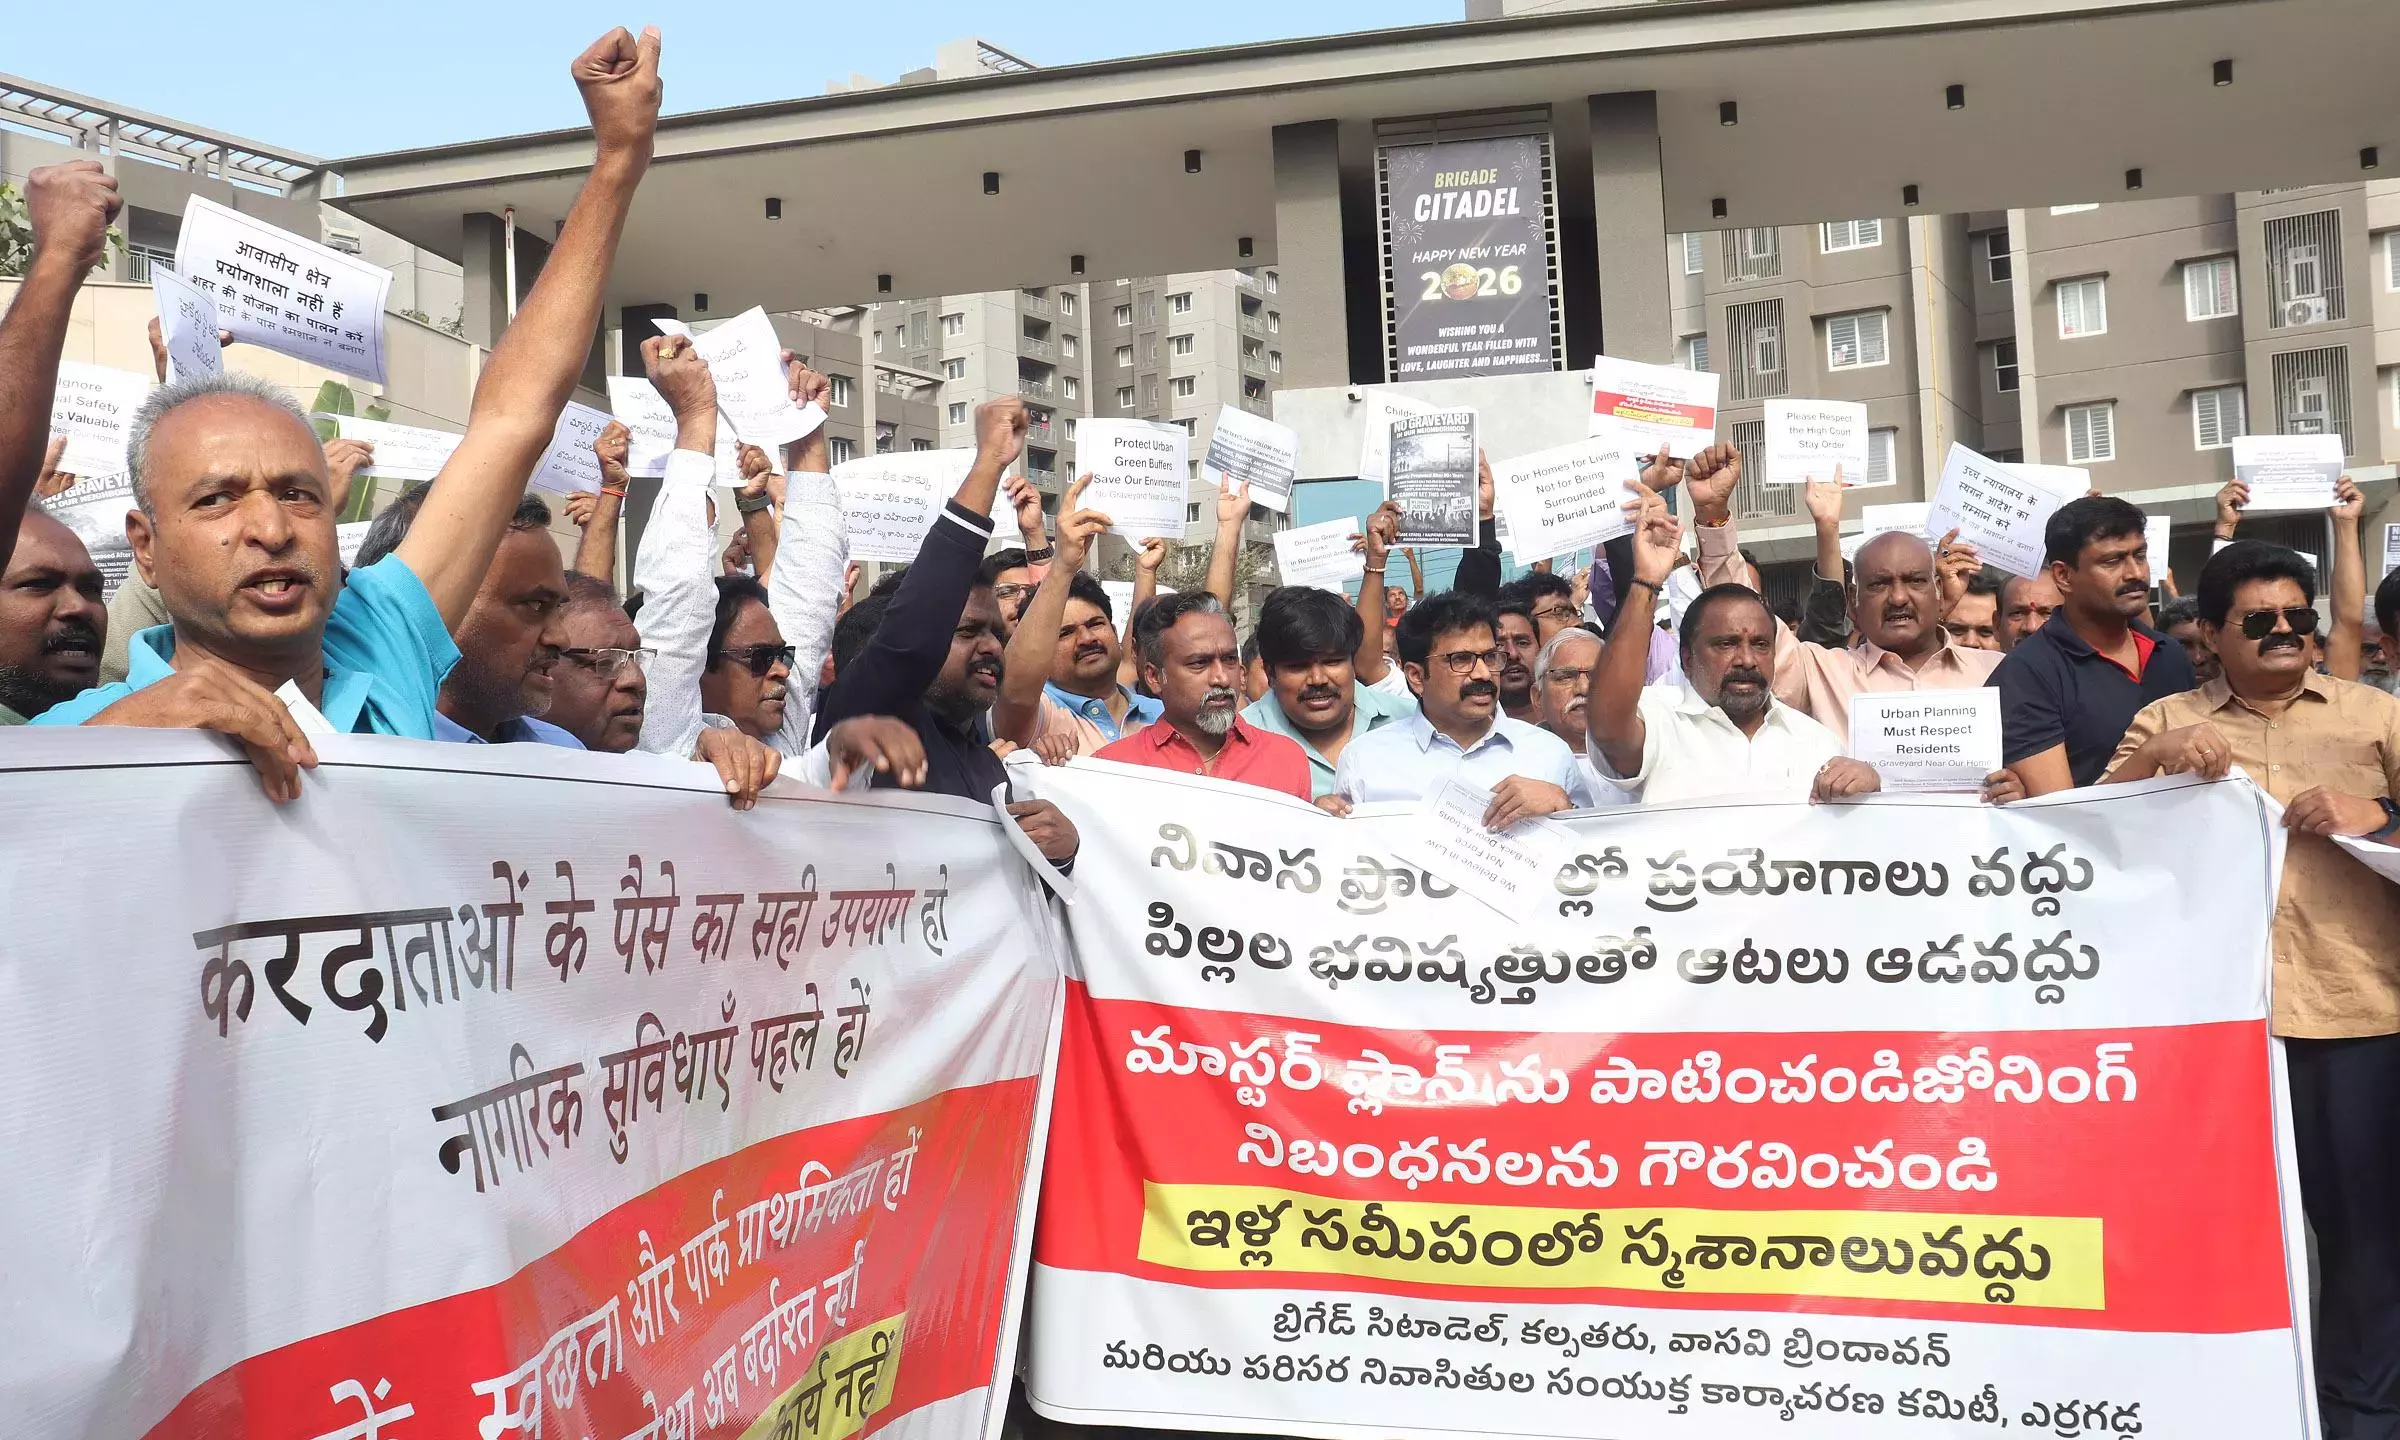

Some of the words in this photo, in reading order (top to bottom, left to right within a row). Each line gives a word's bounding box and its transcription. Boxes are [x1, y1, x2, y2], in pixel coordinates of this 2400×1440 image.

[1434, 168, 1498, 189] BRIGADE
[1414, 187, 1520, 223] CITADEL
[1412, 249, 1454, 264] HAPPY
[1458, 246, 1491, 261] NEW
[1493, 243, 1527, 257] YEAR
[235, 240, 299, 276] आवासीय
[306, 267, 332, 289] क्षेत्र
[216, 259, 290, 299] प्रयोगशाला
[297, 290, 324, 312] नहीं
[192, 274, 217, 293] शहर
[222, 285, 237, 300] की
[243, 295, 279, 316] योजना
[285, 310, 300, 323] का
[307, 317, 338, 335] पालन
[256, 317, 276, 330] पास
[1438, 325, 1476, 337] WISHING
[1479, 324, 1496, 335] YOU
[1497, 323, 1505, 334] A
[1407, 342, 1460, 356] WONDERFUL
[1461, 341, 1483, 353] YEAR
[1485, 340, 1512, 351] FILLED
[1514, 337, 1538, 349] WITH
[1400, 360, 1424, 373] LOVE,
[1426, 358, 1469, 370] LAUGHTER
[1471, 356, 1490, 367] AND
[58, 377, 103, 393] Ignore
[76, 396, 119, 414] Safety
[68, 411, 120, 430] Valuable
[1408, 413, 1470, 429] GRAVEYARD
[1786, 412, 1817, 421] Please
[1819, 412, 1852, 422] Respect
[1789, 426, 1804, 435] the
[1807, 426, 1827, 436] High
[1829, 427, 1851, 437] Court
[1114, 437, 1151, 450] Protect
[1153, 440, 1174, 452] Urban
[1798, 440, 1819, 450] Stay
[1821, 440, 1845, 449] Order
[1114, 456, 1147, 468] Green
[1149, 458, 1173, 471] Buffers
[1510, 473, 1530, 484] Our
[1533, 464, 1570, 478] Homes
[1572, 458, 1586, 468] for
[1589, 451, 1620, 463] Living
[64, 471, 132, 499] GRAVEYA
[1094, 474, 1121, 484] Save
[1124, 475, 1142, 485] Our
[1144, 476, 1181, 488] Environment
[1536, 483, 1555, 494] Not
[1558, 479, 1572, 488] for
[1575, 471, 1605, 484] Being
[1962, 465, 1981, 480] उच्च
[1983, 475, 2024, 500] न्यायालय
[2027, 494, 2038, 507] के
[1544, 486, 1606, 509] Surrounded
[1542, 517, 1555, 527] by
[1557, 507, 1588, 523] Burial
[1590, 500, 1616, 514] Land
[1962, 501, 1992, 522] सम्मान
[1986, 496, 2013, 514] आदेश
[2016, 509, 2030, 522] का
[1881, 708, 1920, 719] Urban
[1924, 706, 1977, 717] Planning
[1883, 726, 1916, 737] Must
[1920, 725, 1972, 737] Respect
[1896, 743, 1961, 754] Residents
[1879, 759, 1923, 769] Graveyard
[1925, 759, 1945, 767] Near
[1948, 759, 1964, 767] Our
[1966, 759, 1992, 767] Home
[1439, 810, 1474, 834] Actions
[1426, 839, 1447, 856] Law
[1455, 837, 1484, 857] Force
[1475, 832, 1498, 848] Door
[1449, 851, 1460, 861] in
[1486, 854, 1505, 869] Not
[1500, 844, 1523, 861] Back
[1524, 857, 1538, 869] No
[1150, 821, 1322, 895] నివాస
[1644, 847, 1949, 912] ప్రయోగాలు
[1967, 842, 2095, 917] వద్దు
[1461, 857, 1498, 882] Believe
[1500, 879, 1517, 893] We
[192, 860, 530, 1044] करदाताओं
[545, 860, 595, 983] के
[613, 853, 681, 976] पैसे
[691, 893, 745, 964] का
[751, 864, 818, 972] सही
[822, 862, 916, 949] उपयोग
[921, 863, 949, 957] हो
[1143, 901, 1293, 984] పిల్లల
[1308, 925, 1658, 1005] భవిష్యత్తుతో
[1677, 938, 1849, 984] ఆటలు
[1866, 929, 2101, 1005] ఆడవద్దు
[1125, 1025, 1321, 1109] మాస్టర్
[431, 1042, 585, 1193] नागरिक
[598, 989, 740, 1165] सुविधाएँ
[750, 982, 825, 1094] पहले
[834, 977, 872, 1079] हों
[1237, 1121, 1619, 1190] నిబంధనలను
[1639, 1136, 1998, 1192] గౌరవించండి
[628, 1230, 683, 1346] और
[681, 1188, 730, 1305] पार्क
[735, 1160, 879, 1270] प्राथमिकता
[883, 1124, 923, 1212] हों
[1300, 1203, 1604, 1267] సమీపంలో
[1272, 1302, 1356, 1343] బ్రిగేడ్
[1366, 1306, 1509, 1347] సిటాడెల్,
[1519, 1317, 1656, 1358] కల్పతరు,
[1668, 1326, 1771, 1357] వాసవి
[1783, 1327, 1952, 1369] బ్రిందావన్
[702, 1344, 739, 1430] अब
[740, 1277, 817, 1388] बर्दाश्त
[835, 1328, 897, 1419] नहीं
[1102, 1340, 1231, 1377] మరియు
[1242, 1353, 1349, 1385] పరిసర
[1360, 1356, 1535, 1394] నివాసితుల
[1546, 1365, 1693, 1415] సంయుక్త
[1701, 1379, 1885, 1422] కార్యాచరణ
[1897, 1384, 2008, 1428] కమిటీ,
